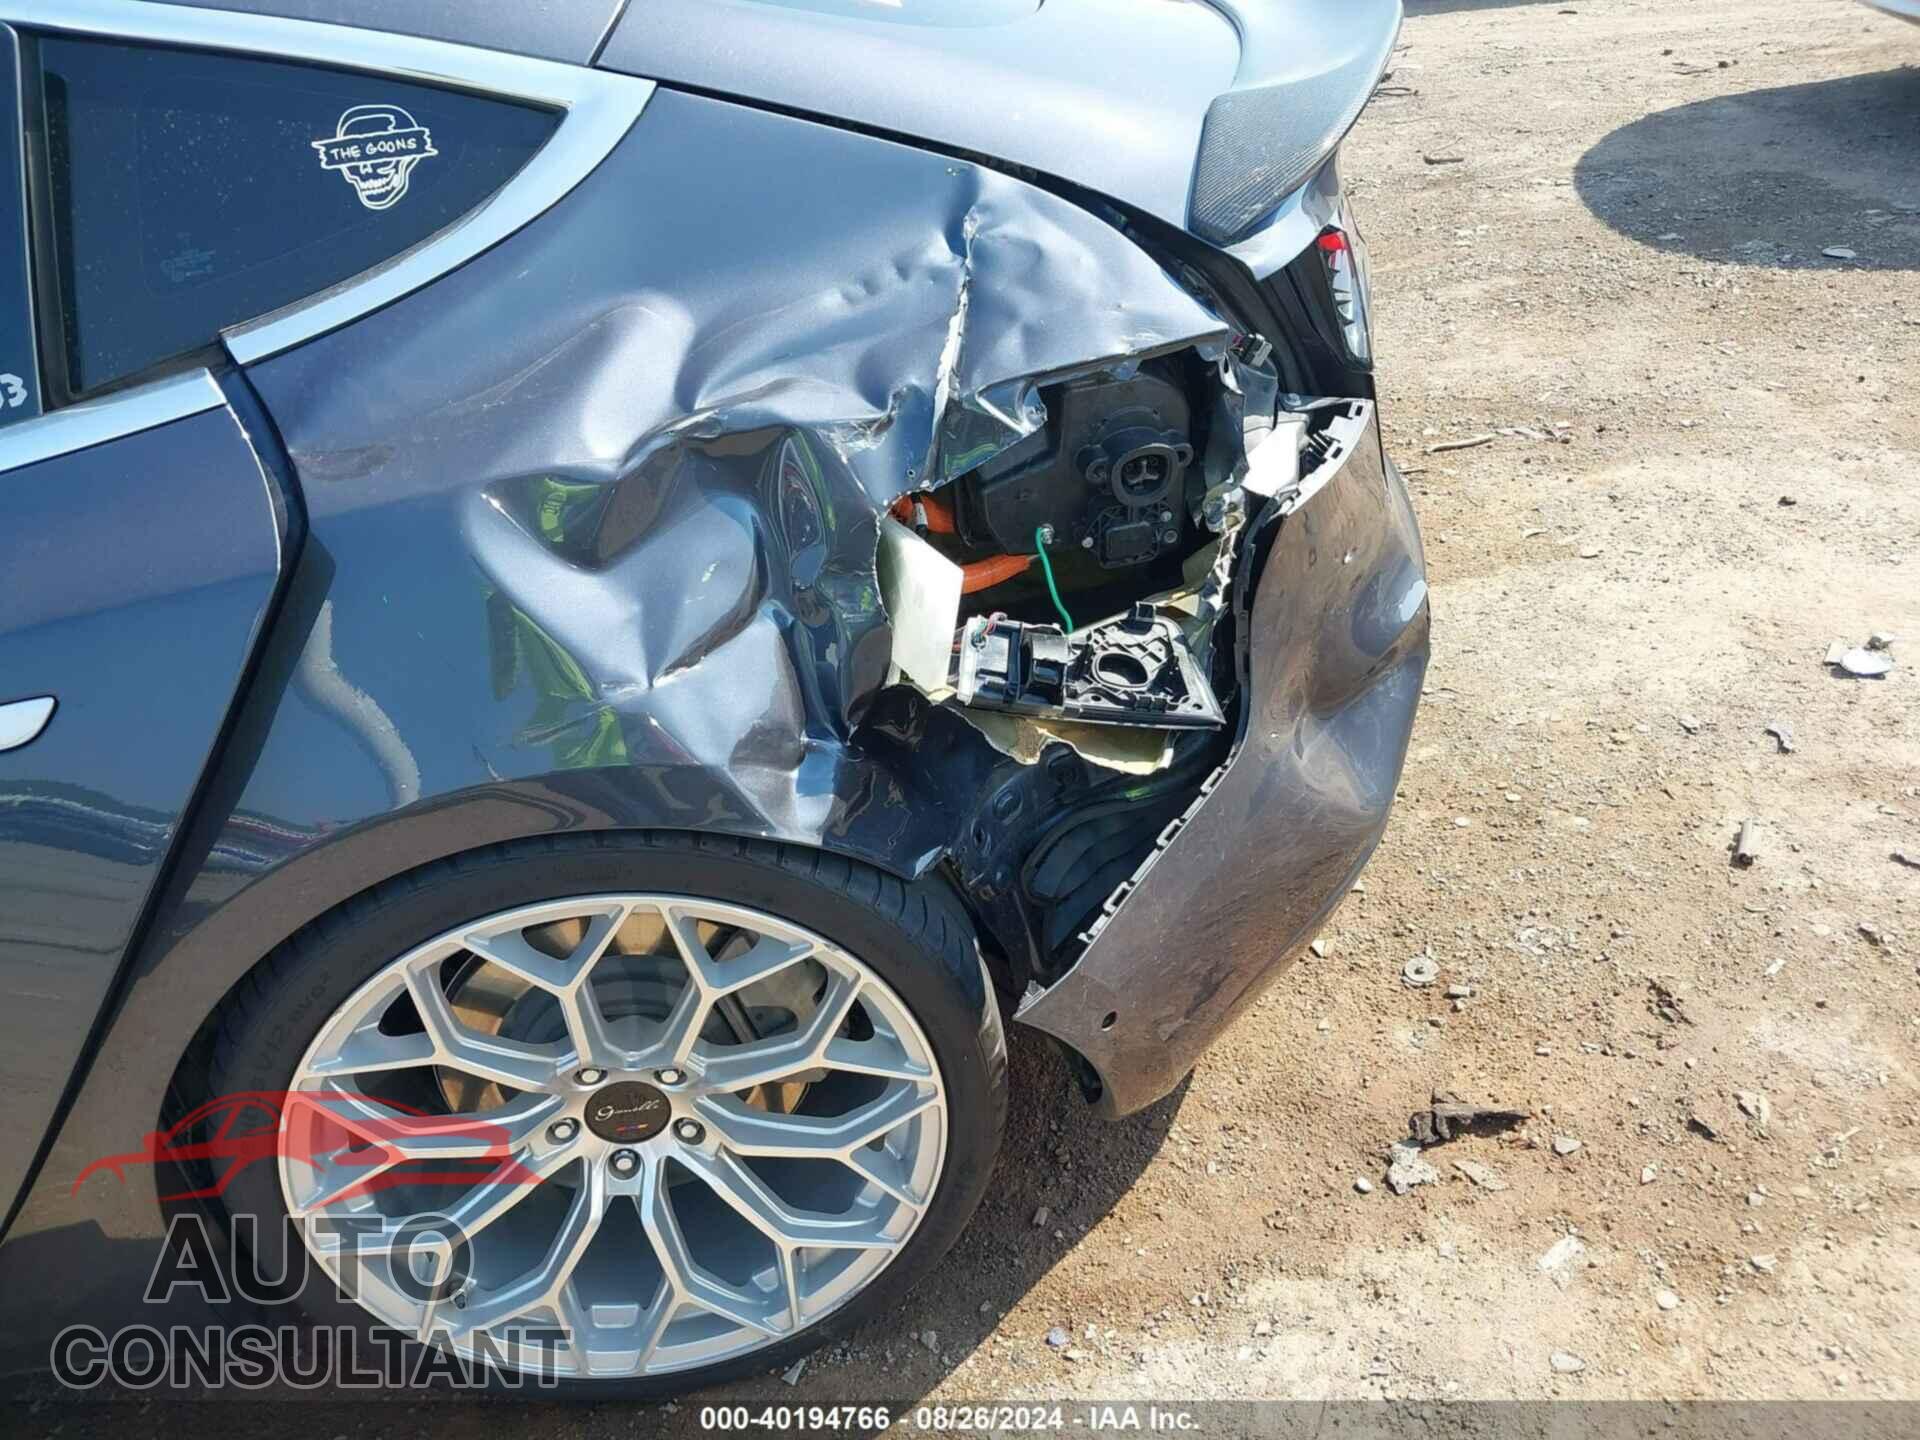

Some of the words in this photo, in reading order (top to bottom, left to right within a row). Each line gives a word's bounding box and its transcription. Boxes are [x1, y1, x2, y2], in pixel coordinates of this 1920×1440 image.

[329, 145, 361, 160] THE
[365, 138, 417, 155] GOONS
[0, 373, 28, 408] 3
